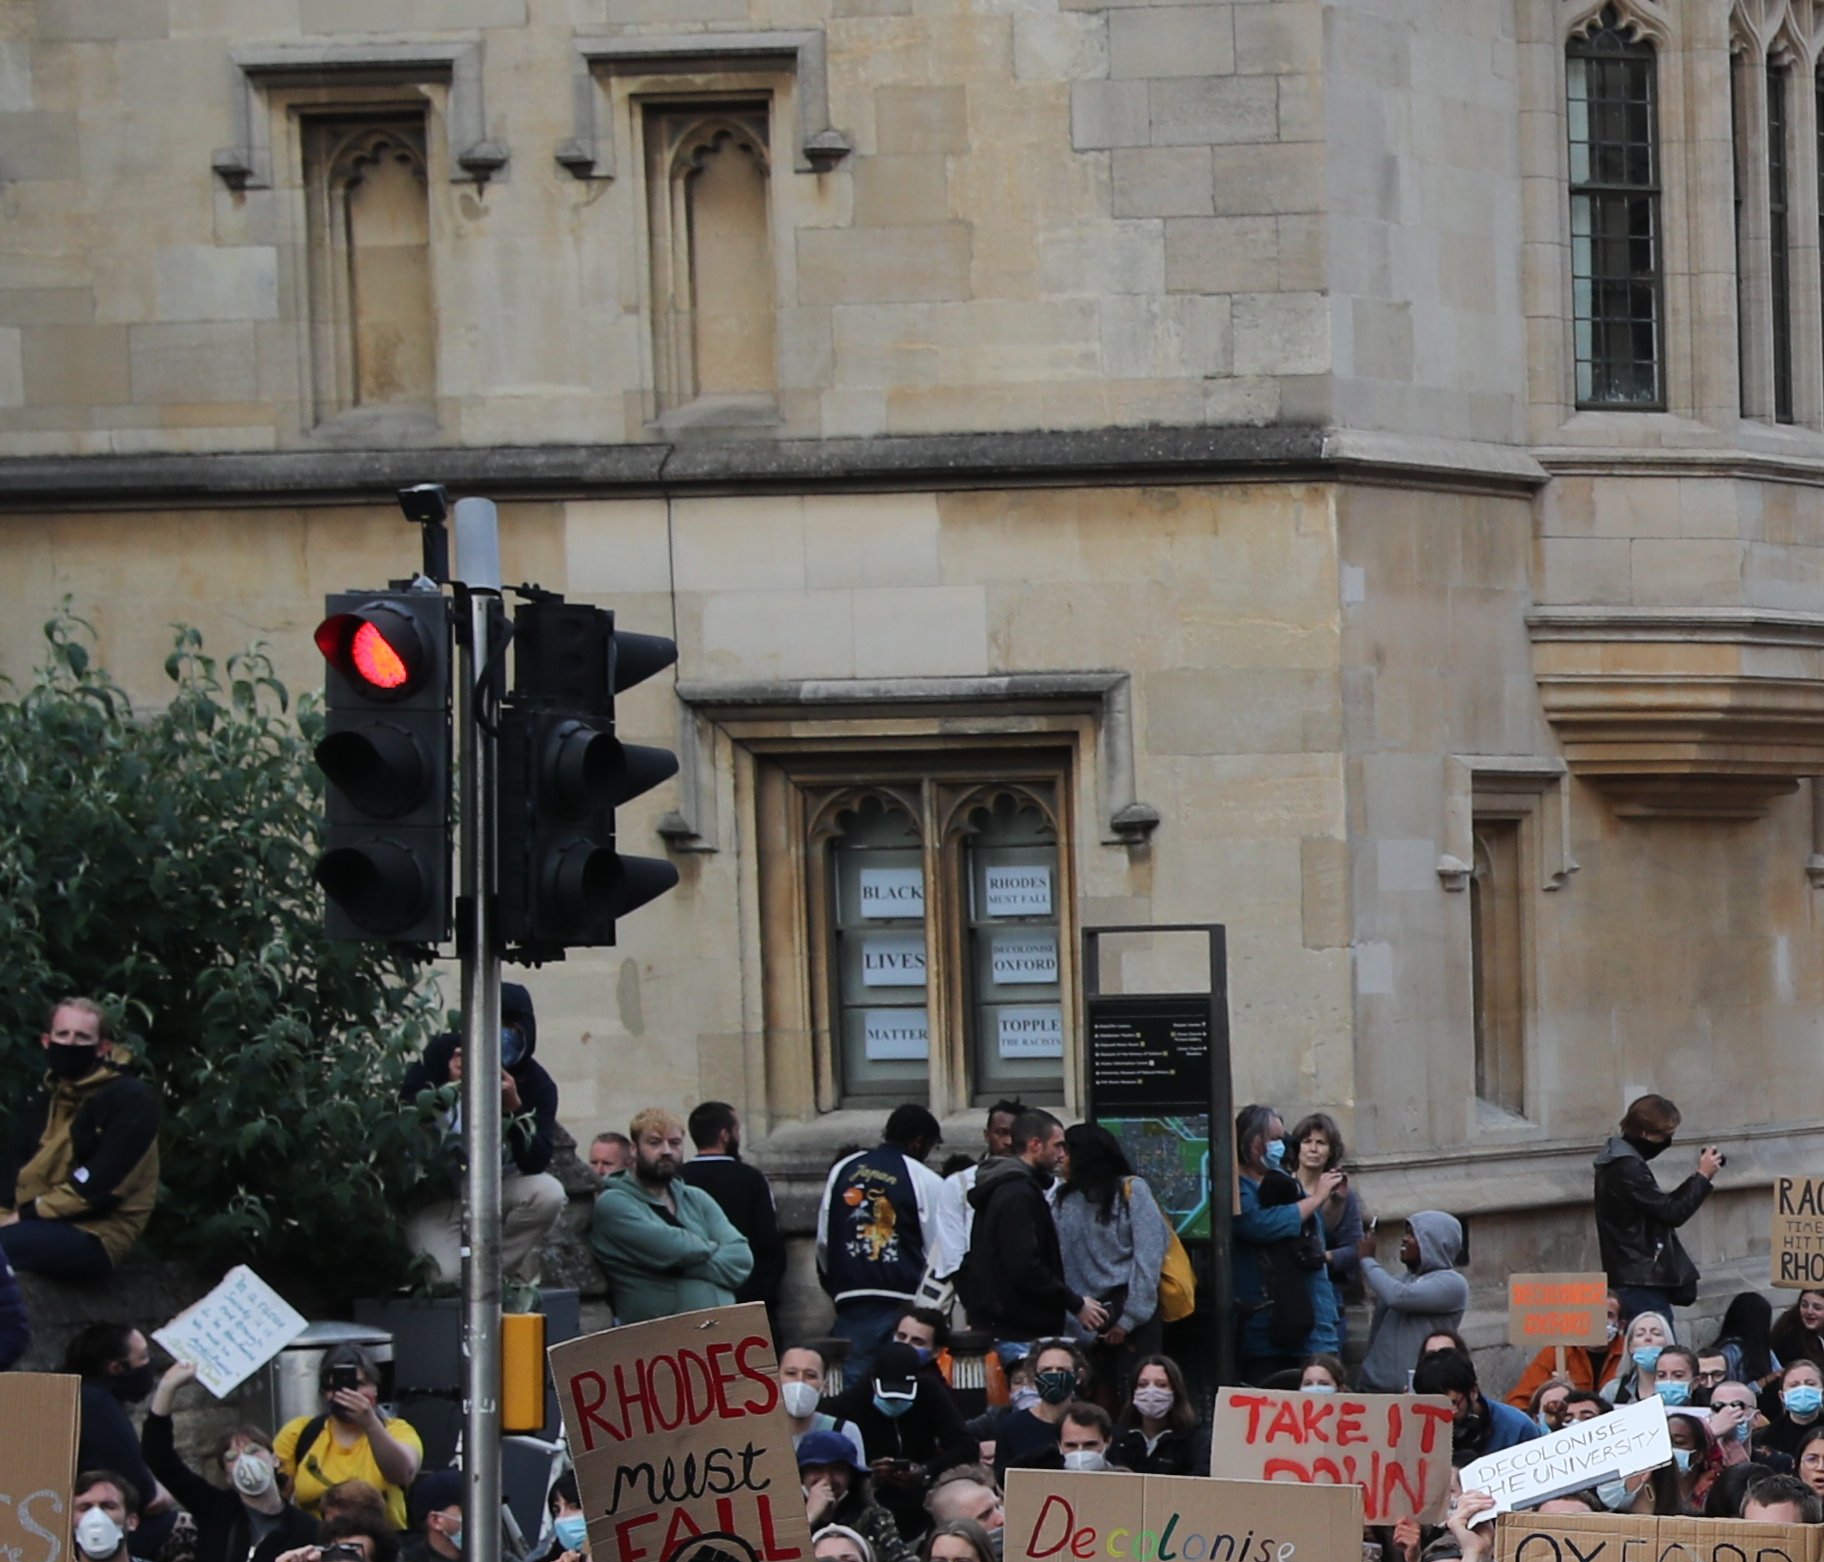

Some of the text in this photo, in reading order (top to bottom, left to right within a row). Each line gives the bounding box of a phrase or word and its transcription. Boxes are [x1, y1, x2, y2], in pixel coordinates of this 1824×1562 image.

[990, 877, 1047, 889] RHODES
[862, 886, 923, 900] BLACK
[989, 893, 1047, 904] MUST FALL
[866, 953, 925, 970] LIVES
[994, 959, 1055, 971] OXFORD
[1002, 1018, 1060, 1032] TOPPLE
[868, 1028, 927, 1041] MATTER
[847, 1165, 898, 1185] Japan
[1786, 1220, 1823, 1234] TIME
[1784, 1236, 1811, 1250] HIT
[1512, 1282, 1606, 1305] DECOLONISE
[1524, 1311, 1592, 1336] OXFORD
[570, 1336, 778, 1452] RHODES
[1229, 1395, 1454, 1453] TAKE IT
[1478, 1419, 1626, 1483] DECOLONISE
[1533, 1428, 1660, 1484] UNIVERSITY
[605, 1441, 771, 1515] must
